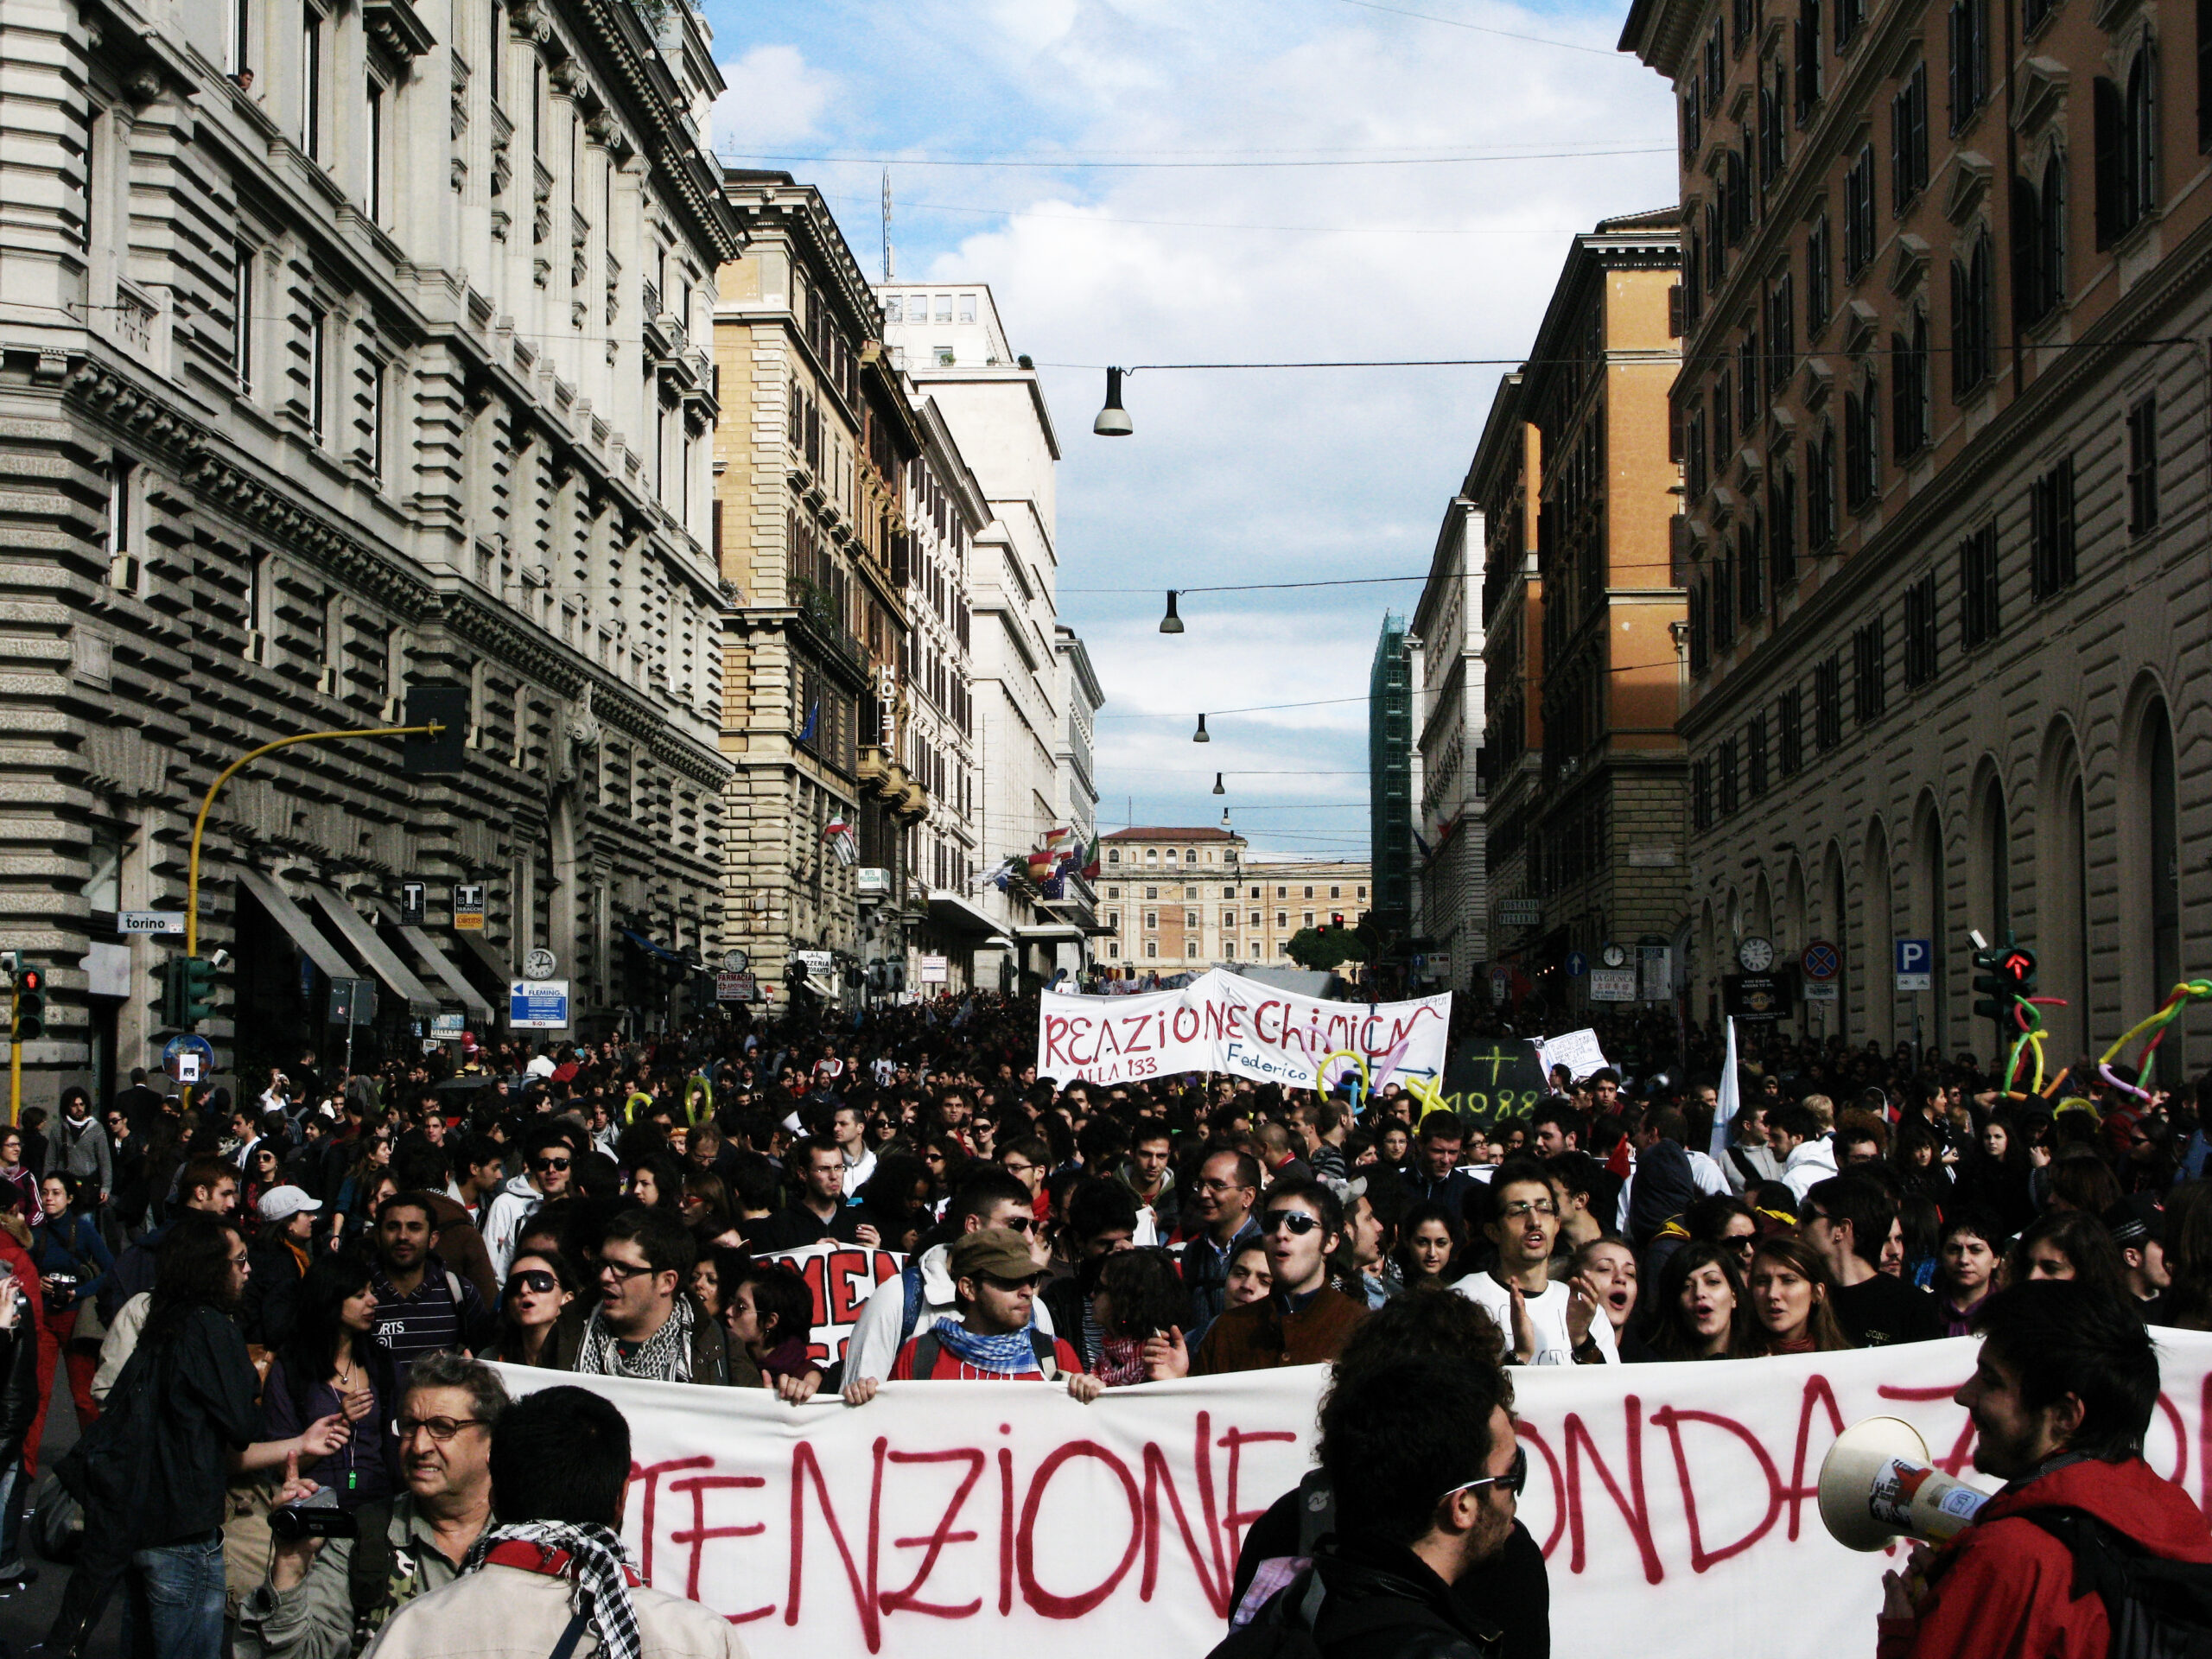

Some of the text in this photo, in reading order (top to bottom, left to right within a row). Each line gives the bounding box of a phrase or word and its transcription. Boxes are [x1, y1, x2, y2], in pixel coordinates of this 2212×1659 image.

[404, 885, 422, 910] T
[460, 886, 480, 904] T
[125, 917, 166, 929] torino
[1903, 943, 1923, 970] P
[1077, 1057, 1158, 1084] ALLA 133
[1227, 1043, 1307, 1080] Federico
